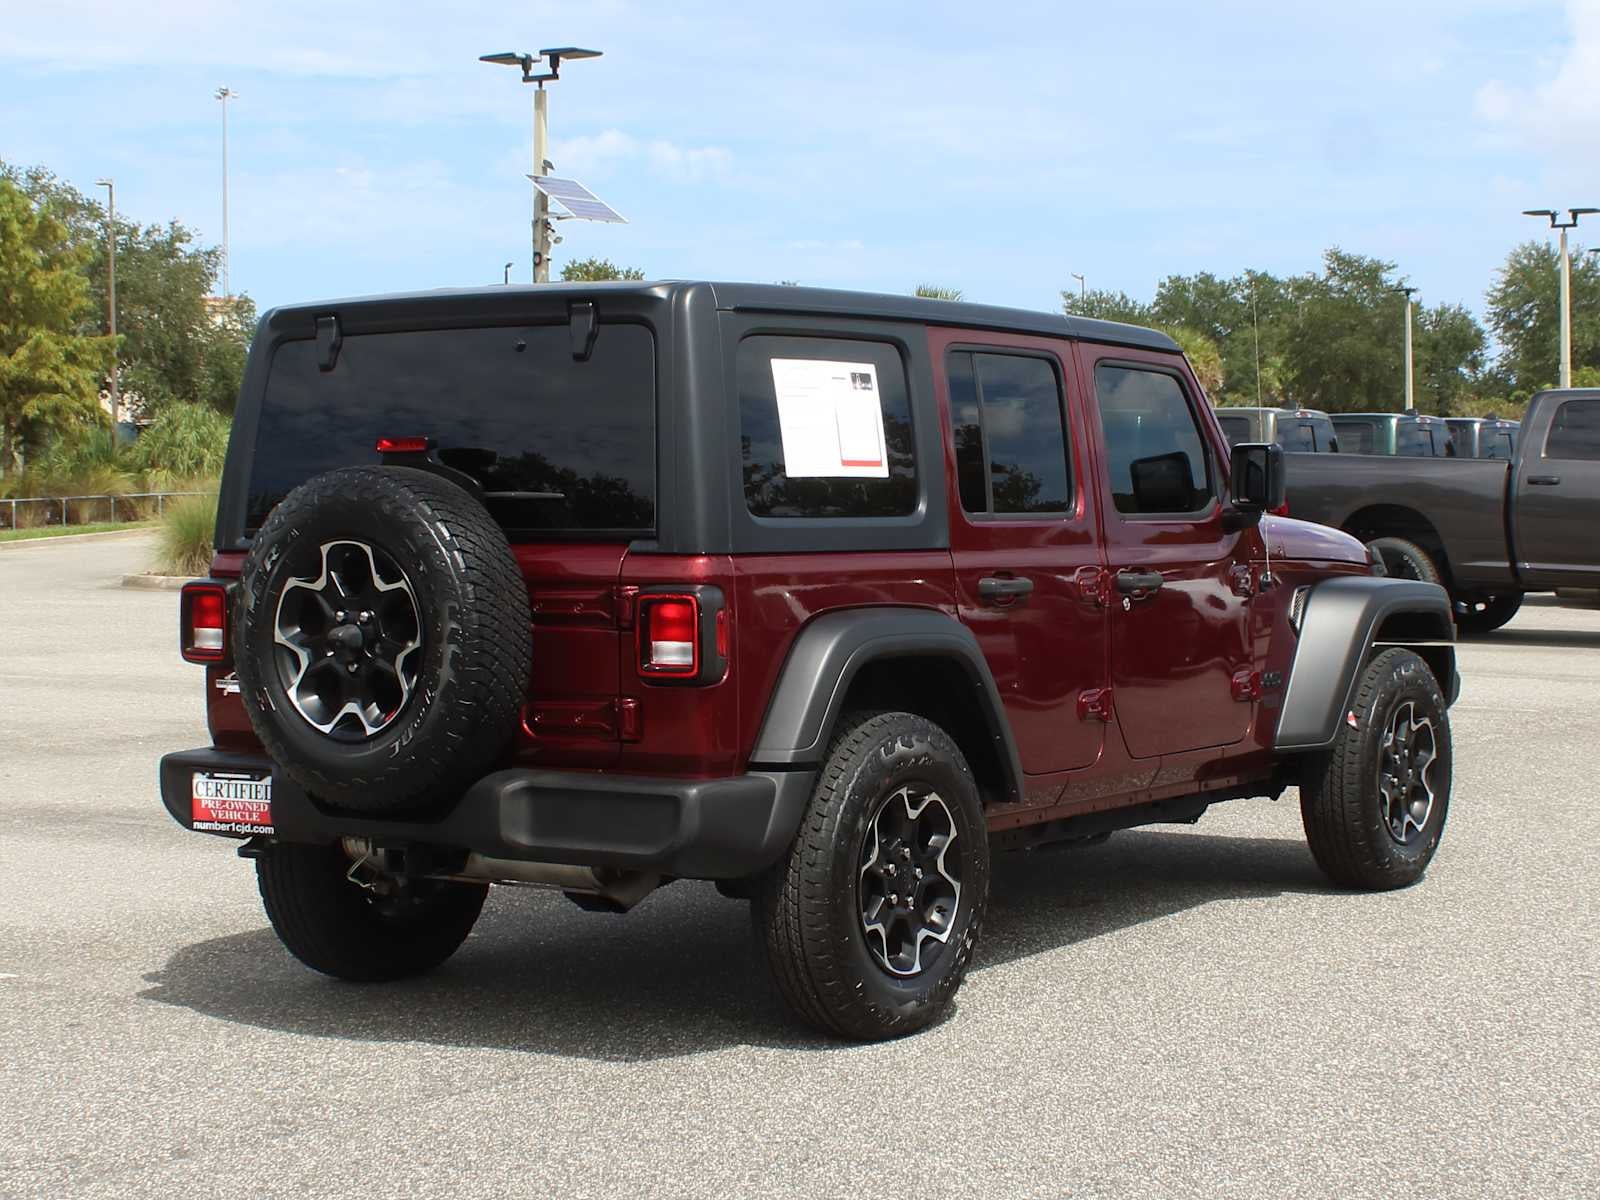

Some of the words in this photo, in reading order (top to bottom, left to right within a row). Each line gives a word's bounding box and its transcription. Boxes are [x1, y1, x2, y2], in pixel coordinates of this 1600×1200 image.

[195, 781, 272, 800] CERTIFIED
[201, 799, 268, 812] PRE-OWNED
[210, 810, 260, 821] VEHICLE
[193, 821, 275, 834] number1cjd.com
